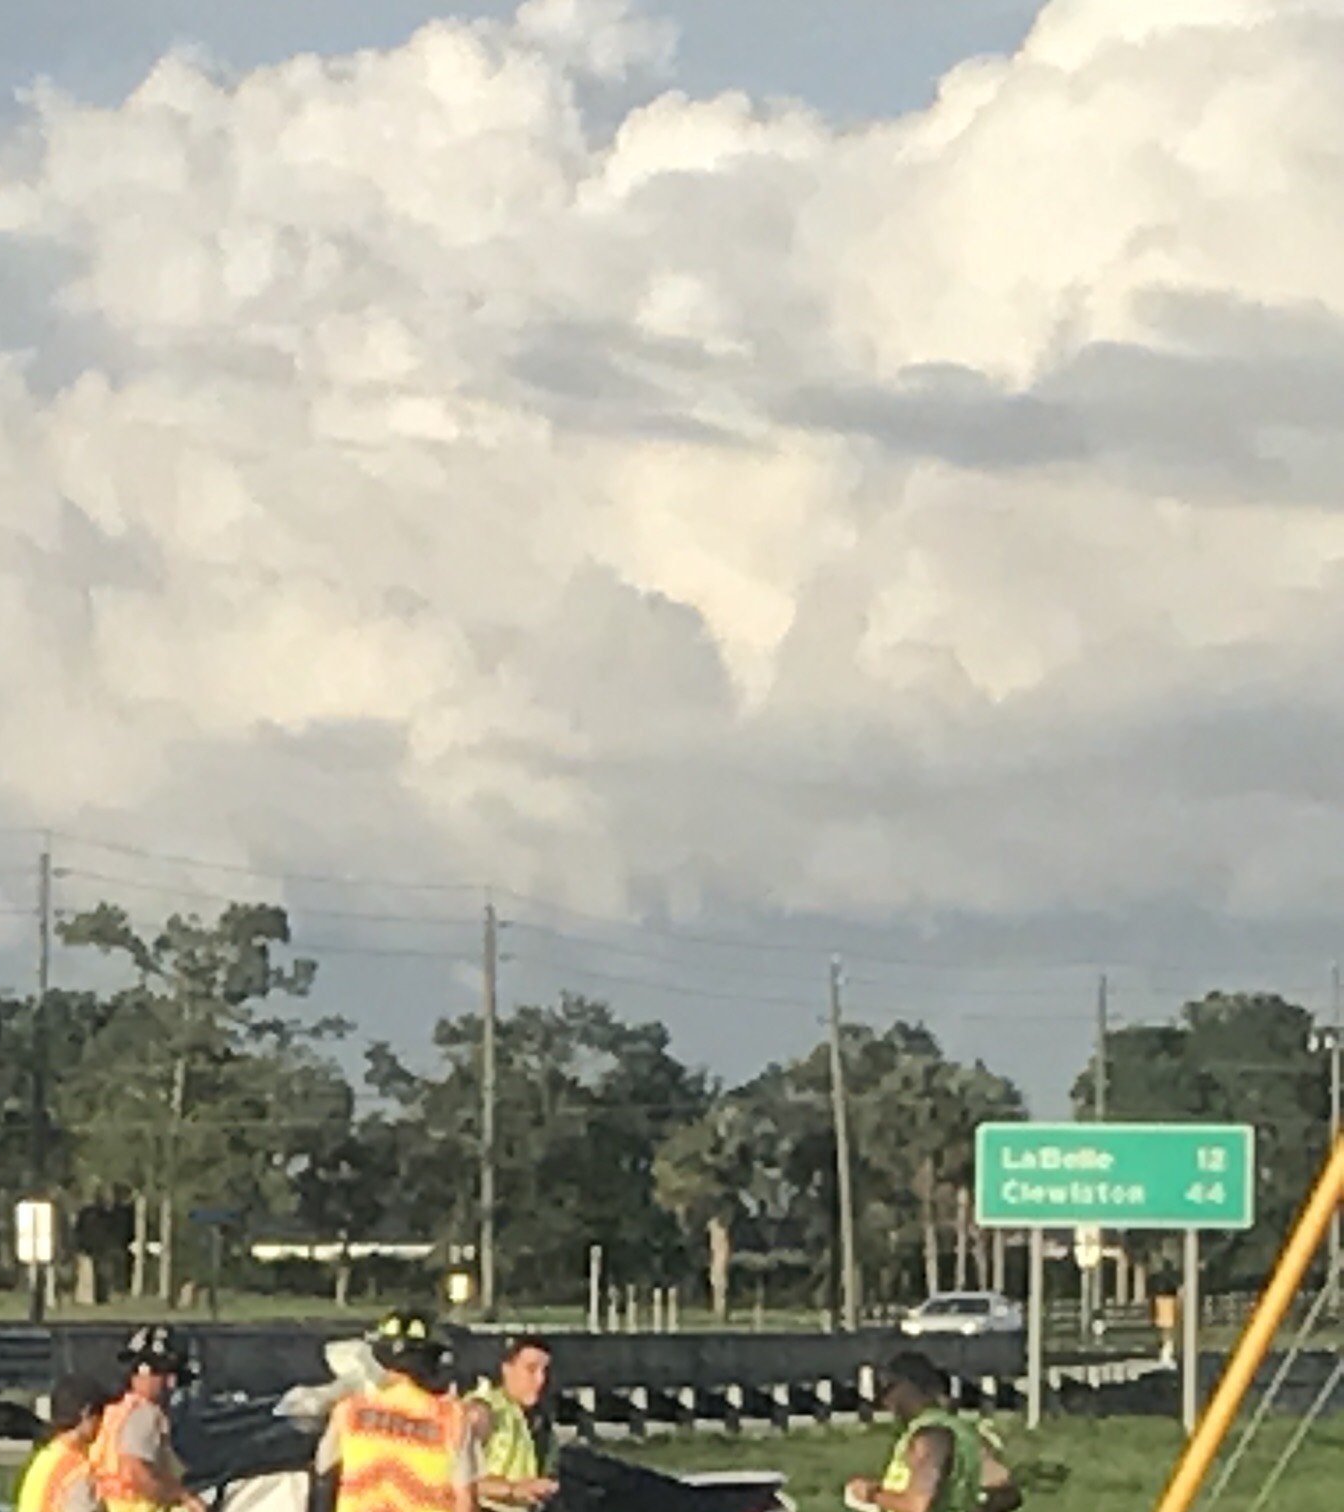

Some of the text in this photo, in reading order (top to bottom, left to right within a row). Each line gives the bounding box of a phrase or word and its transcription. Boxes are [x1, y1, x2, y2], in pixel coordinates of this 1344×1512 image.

[1001, 1146, 1227, 1171] LaBelle 12
[1001, 1178, 1226, 1204] Clewiston 44
